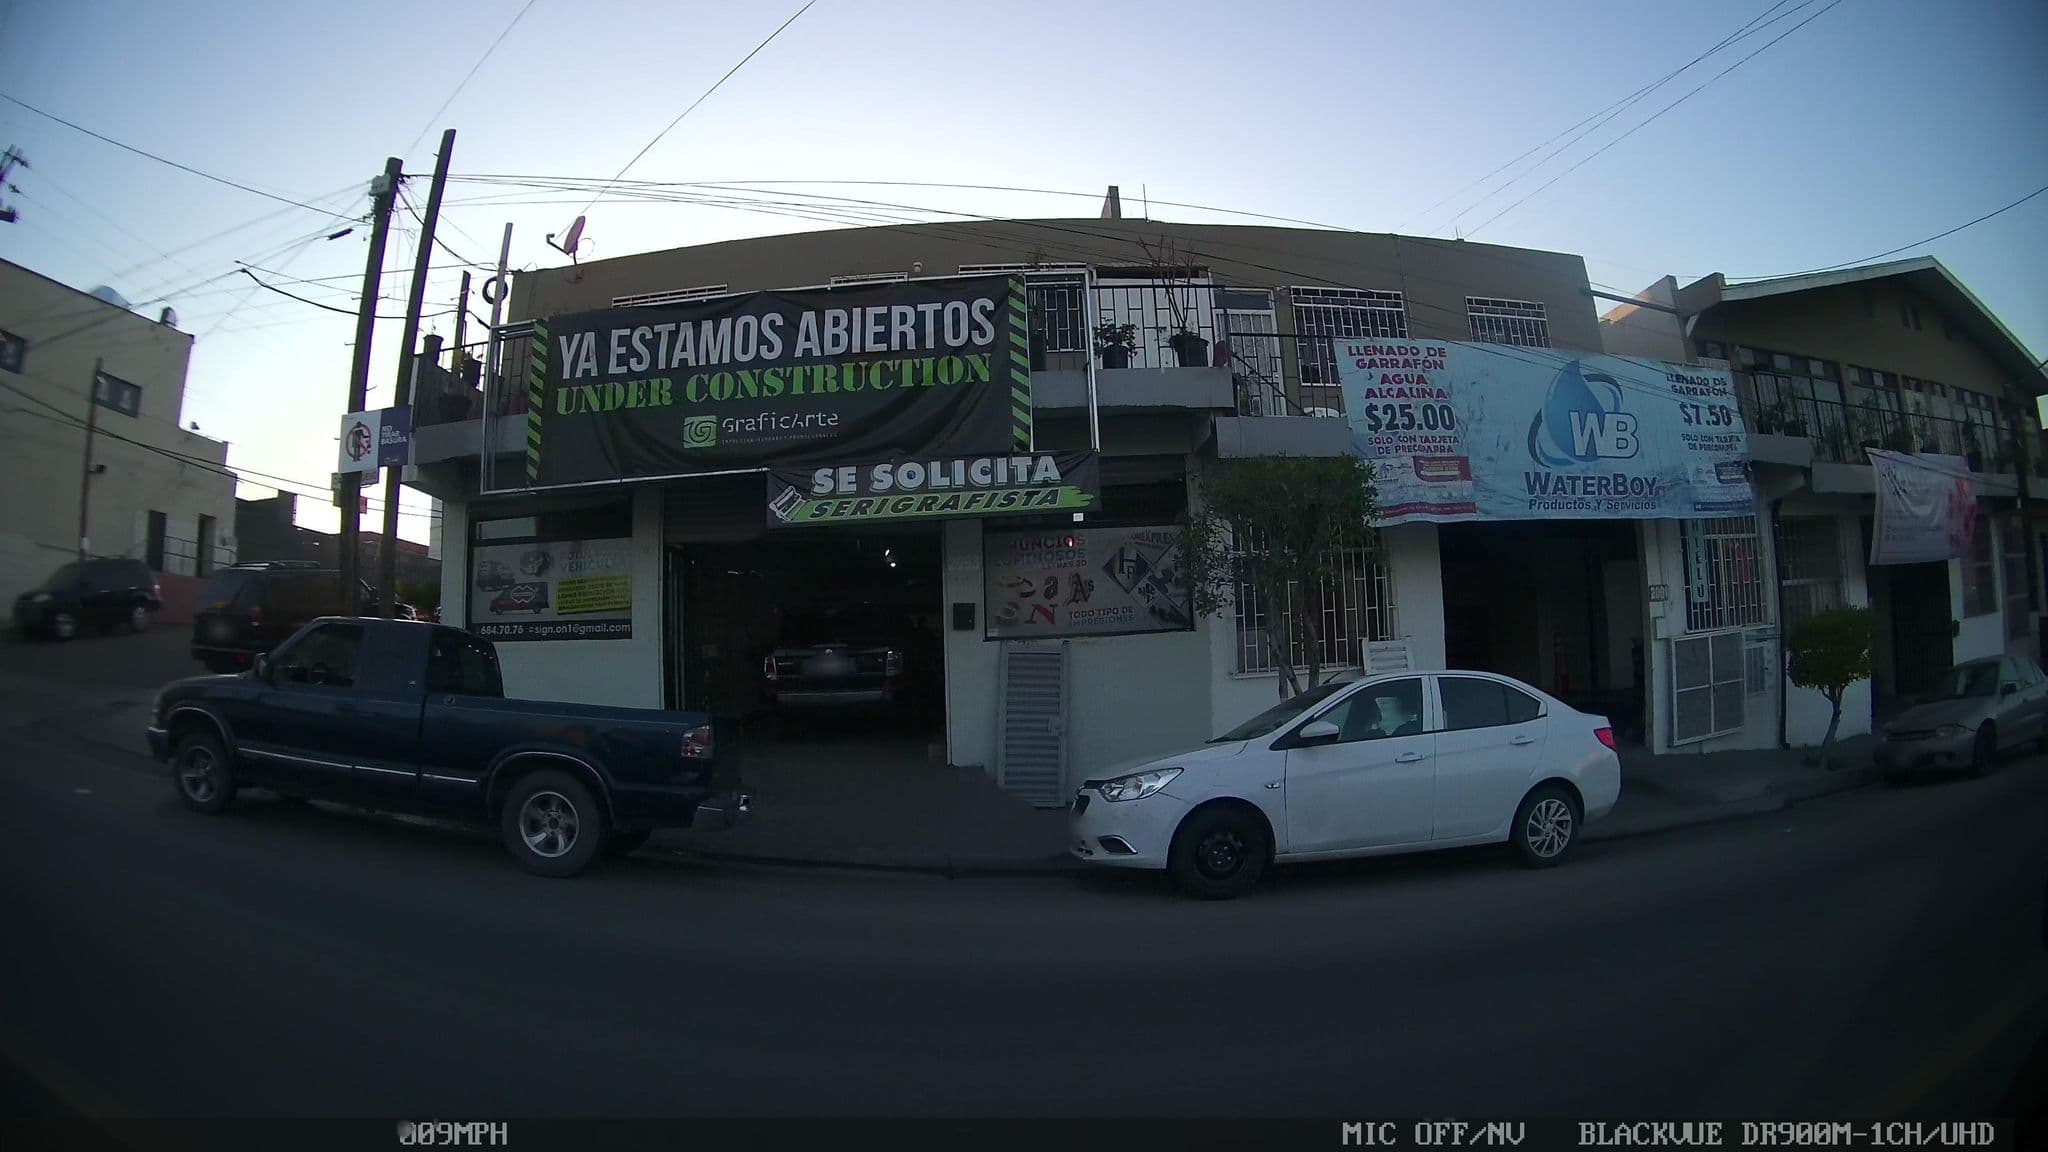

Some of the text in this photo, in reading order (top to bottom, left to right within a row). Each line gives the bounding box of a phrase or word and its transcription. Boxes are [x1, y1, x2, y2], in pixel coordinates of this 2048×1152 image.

[559, 298, 995, 379] YA ESTAMOS ABIERTOS
[1348, 345, 1447, 358] LLENADO DE
[1356, 357, 1445, 370] GARRAFÓN
[556, 353, 992, 416] UNDER CONSTRUCTION
[1380, 373, 1429, 385] AGUA
[1666, 373, 1727, 386] LLENADO DE
[1365, 387, 1449, 400] ALCALINA
[721, 411, 840, 433] GraficArte
[1365, 403, 1456, 434] $25.00
[1680, 402, 1733, 427] $7.50
[1368, 434, 1460, 446] SOLO CON TARJETA
[1568, 409, 1641, 460] WB
[1377, 444, 1454, 455] DE PRECOMPRA
[812, 455, 1062, 495] SE SOLICITA
[809, 489, 1060, 519] SERIGRAFISTA
[1528, 498, 1657, 512] Productos Y Servicios
[1006, 535, 1086, 551] NUNCIOS
